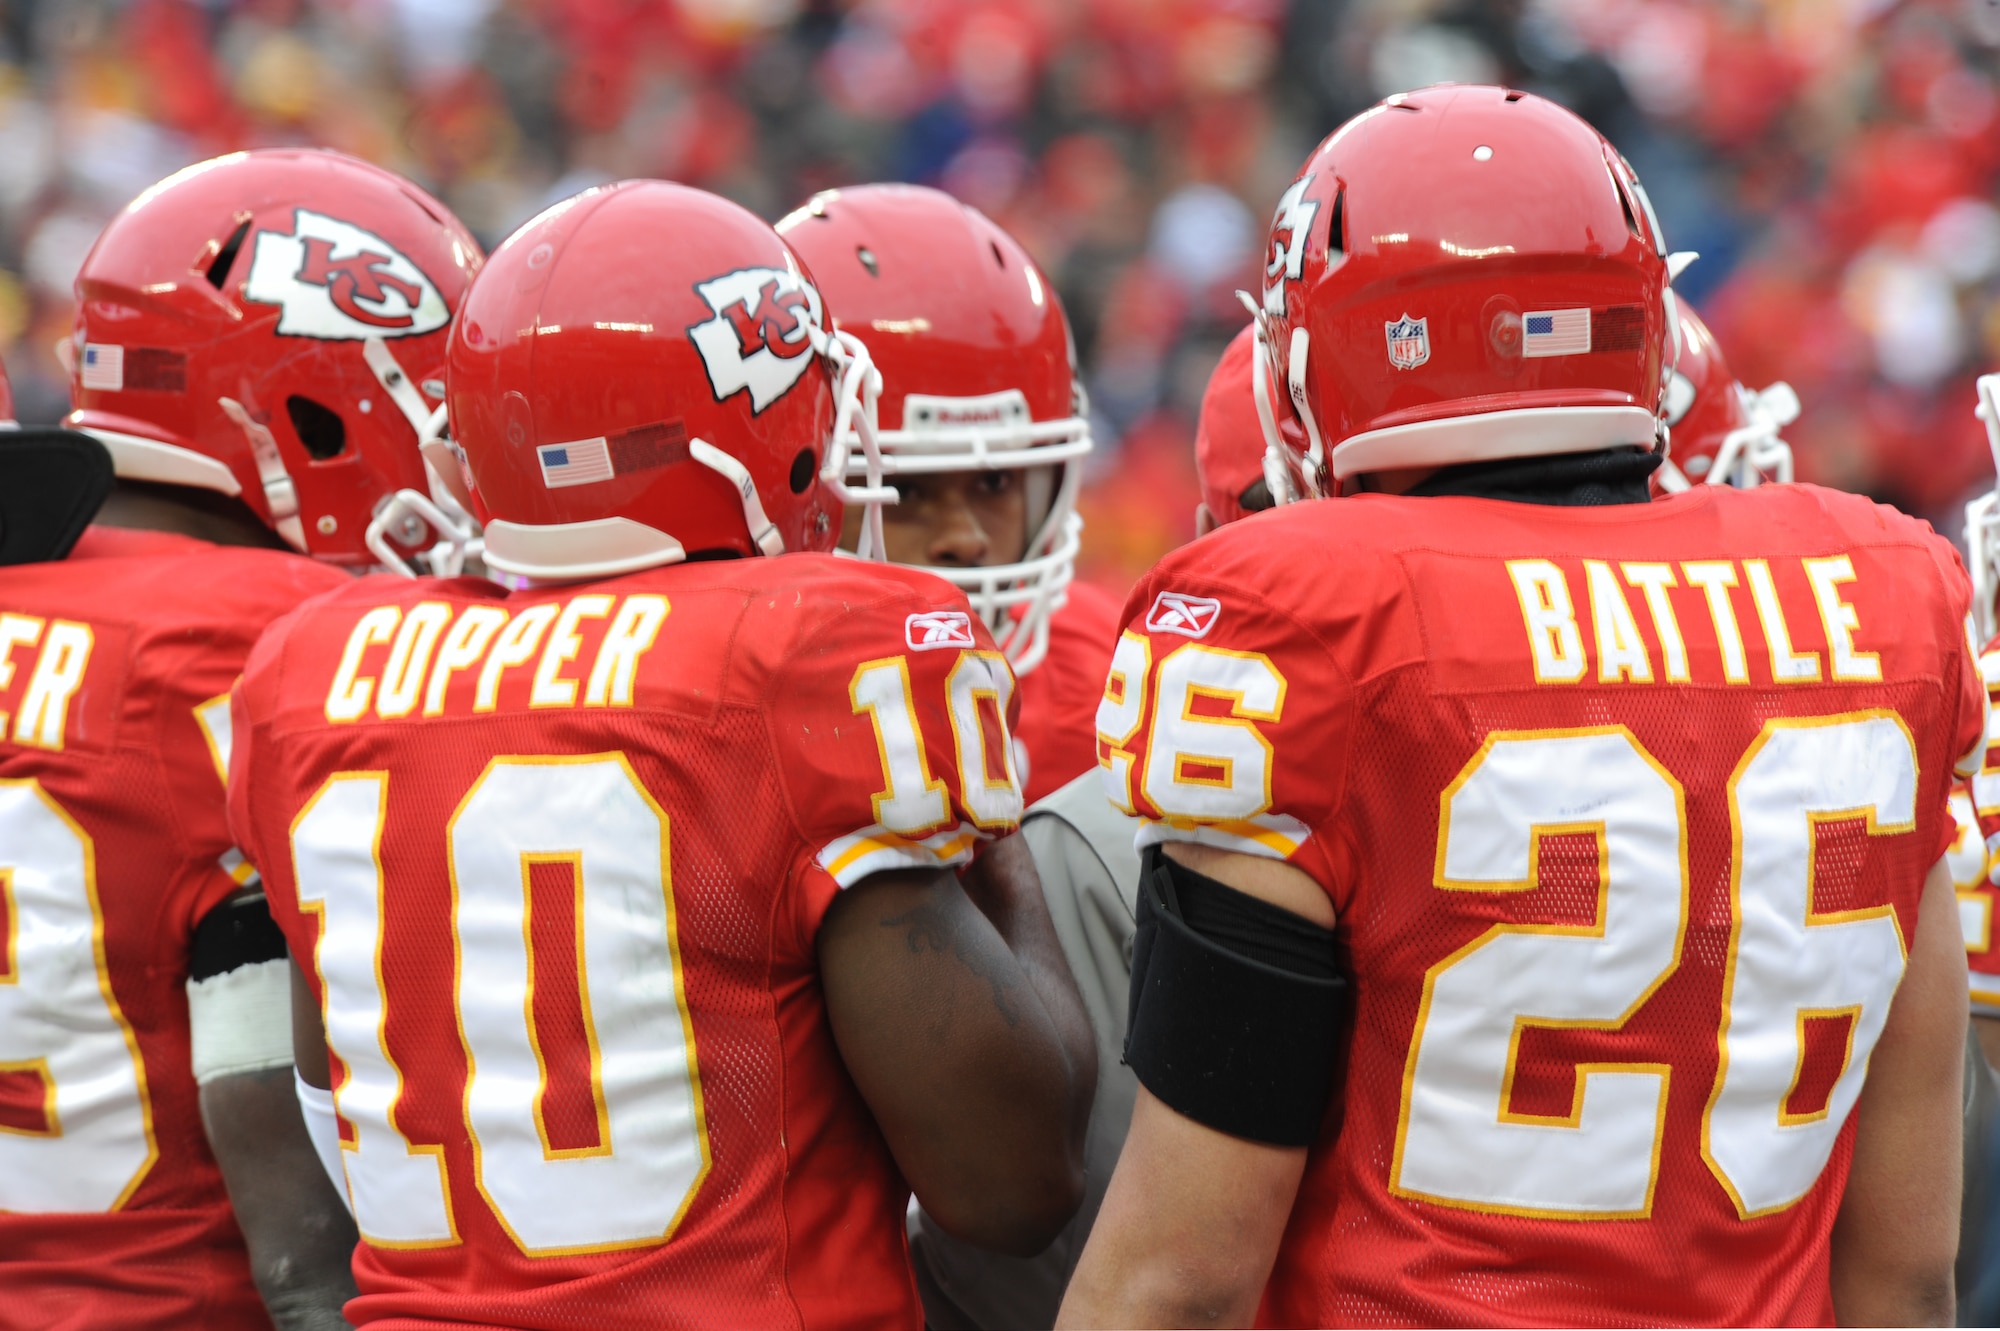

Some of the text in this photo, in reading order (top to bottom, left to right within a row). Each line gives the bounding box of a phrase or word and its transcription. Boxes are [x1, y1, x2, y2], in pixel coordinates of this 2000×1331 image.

[293, 235, 414, 328] KC
[1393, 339, 1424, 360] NFL
[324, 593, 671, 724] COPPER
[1505, 554, 1882, 684] BATTLE
[848, 649, 1025, 835] 10
[289, 751, 712, 1258] 10
[1389, 708, 1920, 1220] 26
